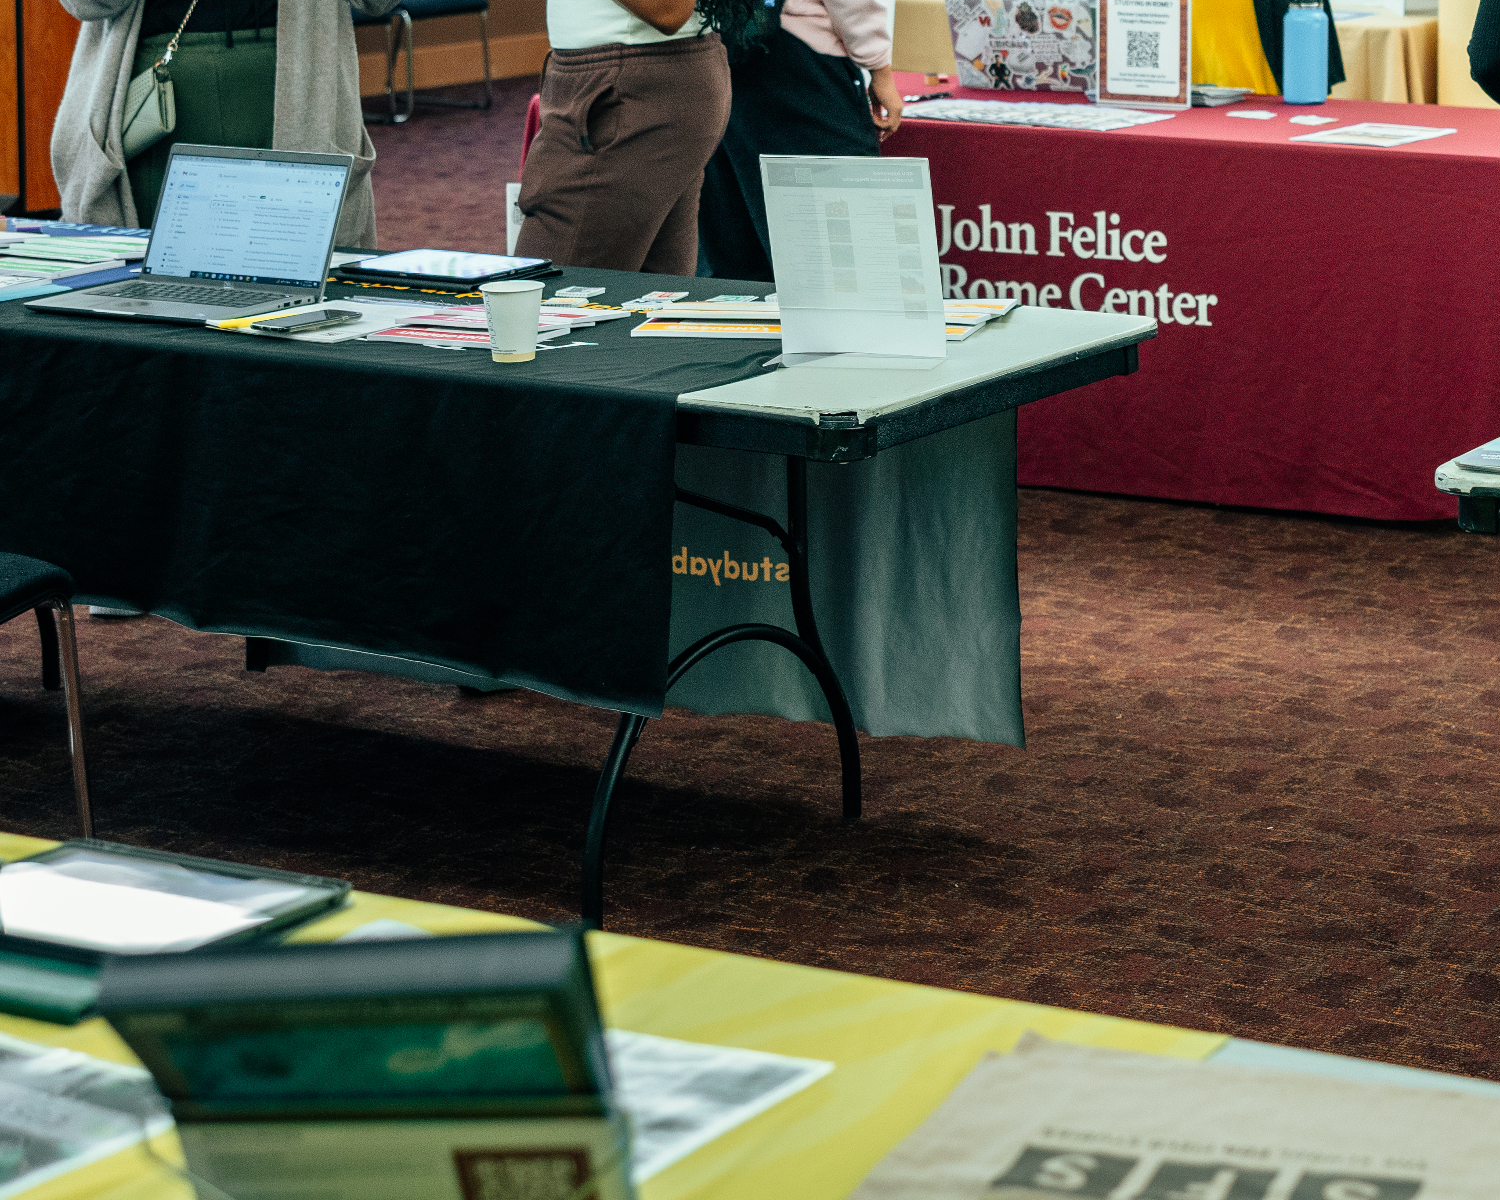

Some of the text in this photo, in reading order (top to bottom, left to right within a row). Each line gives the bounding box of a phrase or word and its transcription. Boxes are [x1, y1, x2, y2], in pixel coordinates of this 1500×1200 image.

[1114, 0, 1145, 7] STUDYING
[938, 203, 1168, 264] John Felice
[939, 263, 1219, 327] Rome Center
[663, 324, 769, 332] LANGUAGES
